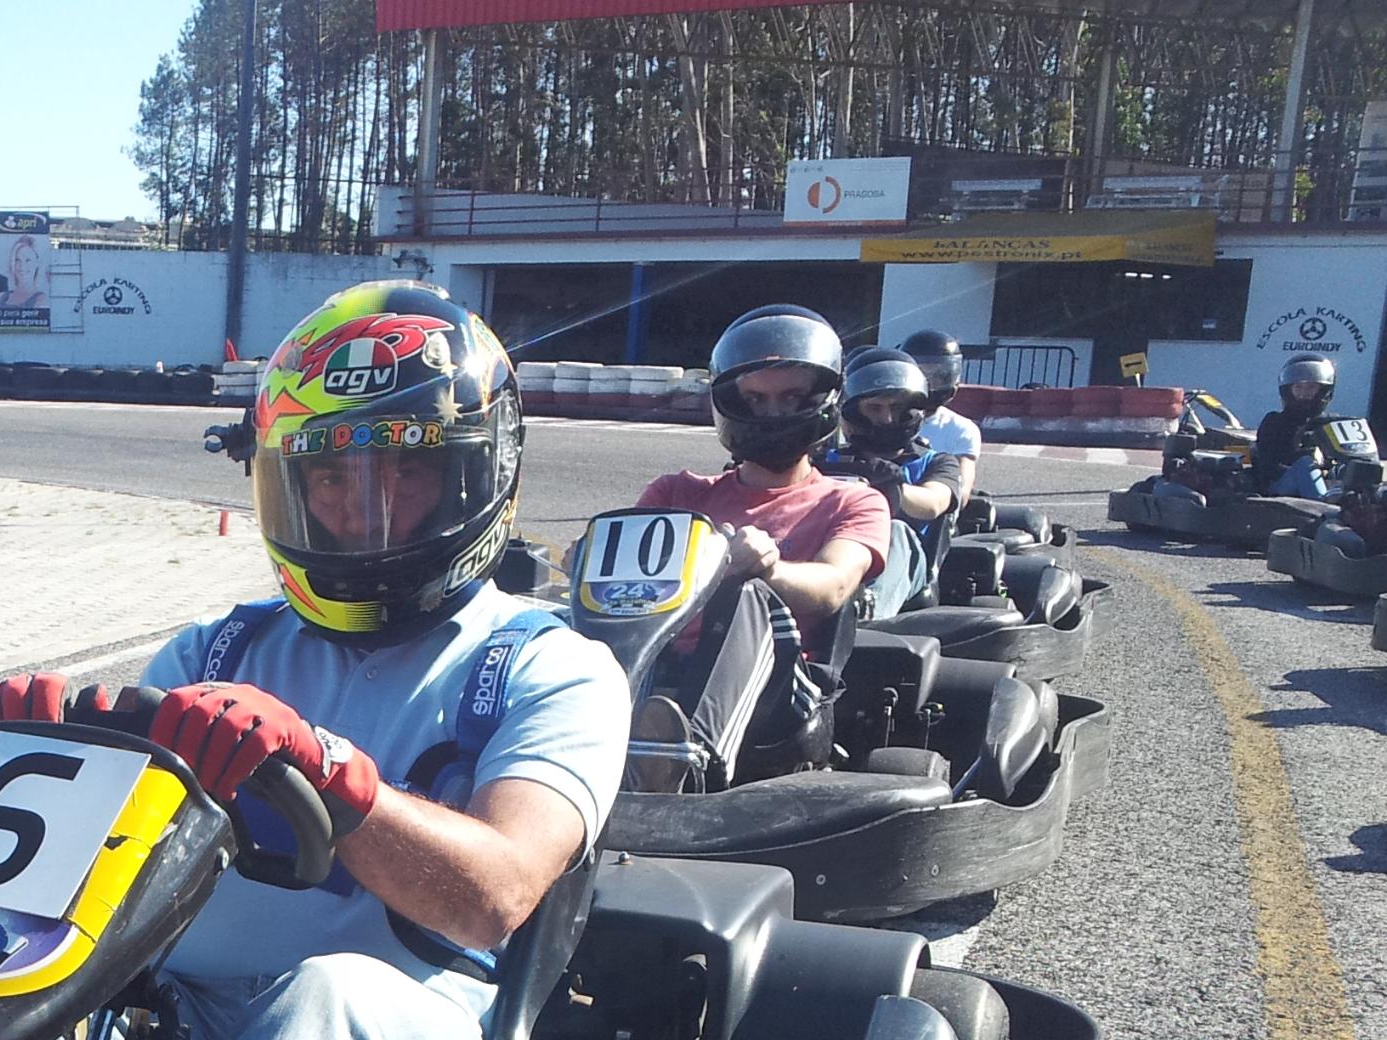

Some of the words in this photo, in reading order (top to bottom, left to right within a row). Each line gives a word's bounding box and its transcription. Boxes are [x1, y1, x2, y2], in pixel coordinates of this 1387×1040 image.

[17, 216, 38, 230] apri
[114, 278, 152, 315] KARTING
[1256, 308, 1307, 350] ESCOLA
[1316, 306, 1367, 353] KARTING
[1283, 341, 1343, 352] EUROINDY
[326, 367, 394, 393] agv
[280, 429, 326, 456] THE
[332, 422, 444, 450] DOCTOR
[1337, 421, 1368, 441] 13
[599, 516, 675, 577] 10
[611, 583, 644, 599] 24
